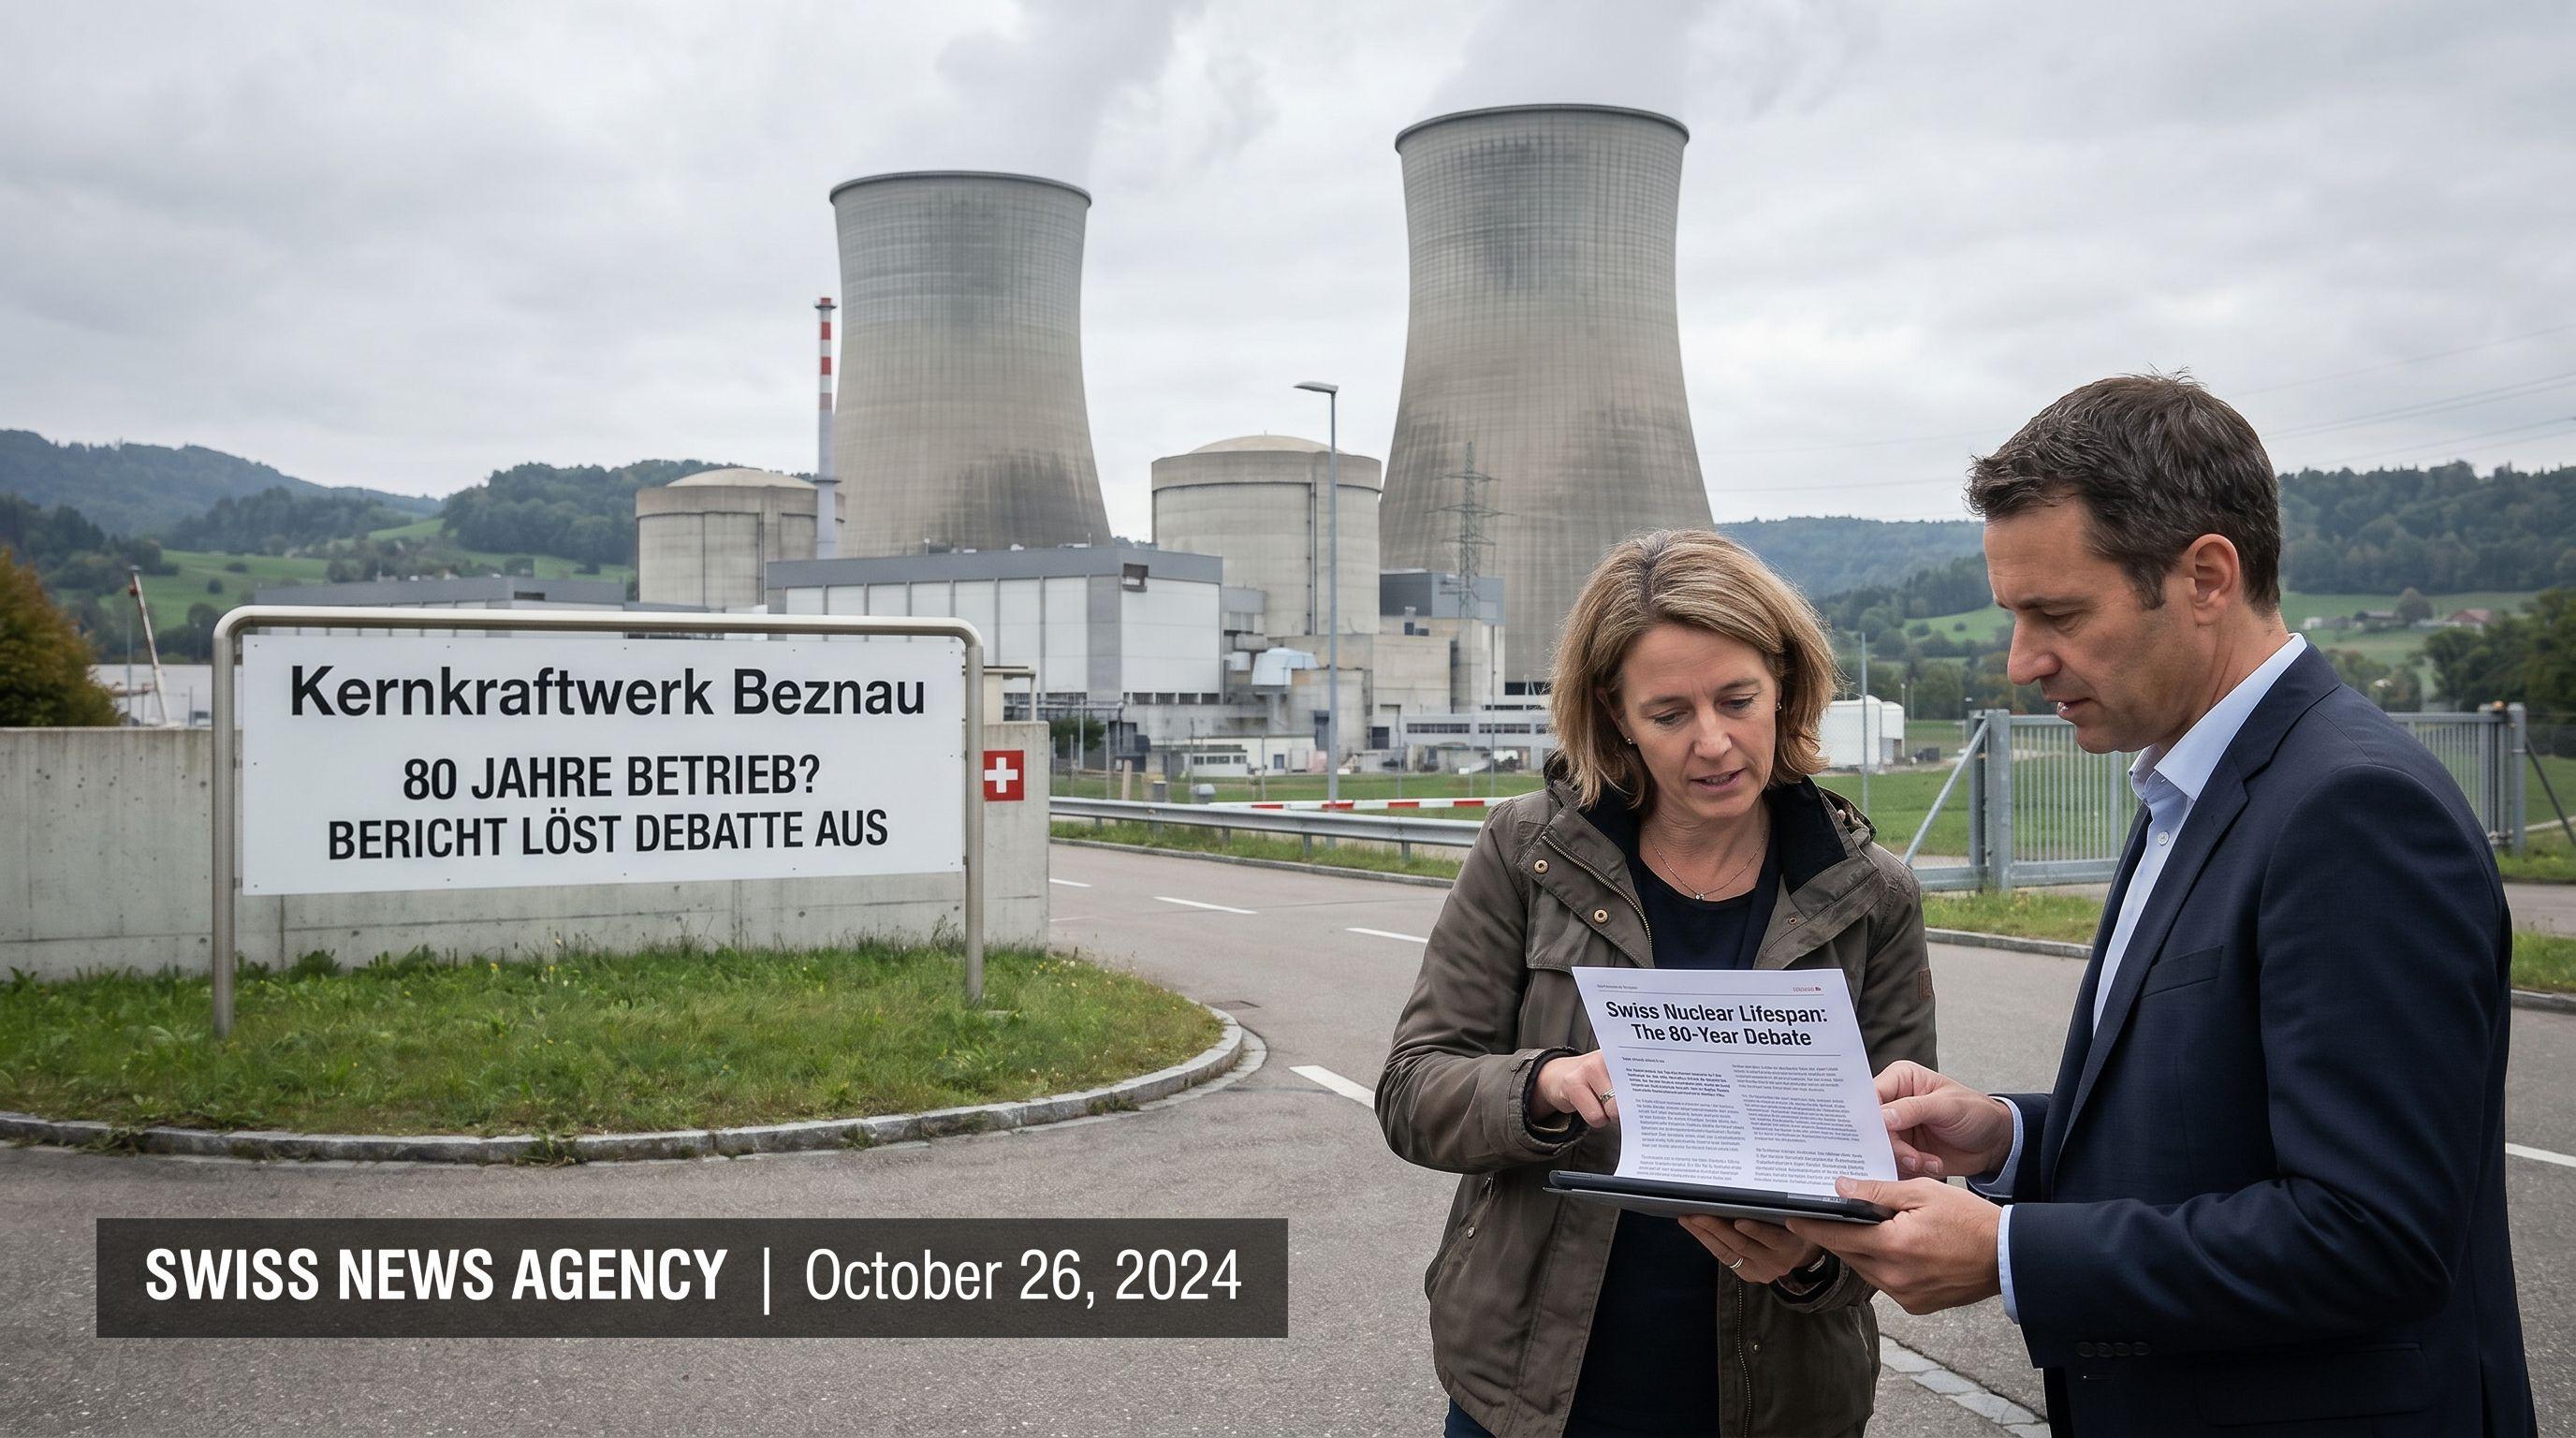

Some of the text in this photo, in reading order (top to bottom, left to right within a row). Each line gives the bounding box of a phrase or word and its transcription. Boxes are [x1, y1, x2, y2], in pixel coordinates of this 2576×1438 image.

[290, 665, 926, 717] Kernkraftwerk Beznau
[402, 754, 820, 800] 80 JAHRE BETRIEB?
[329, 806, 888, 860] BERICHT LÖST DEBATTE AUS
[1605, 1001, 1828, 1027] Swiss Nuclear Lifespan:
[1630, 1023, 1812, 1046] The 80-Year Debate
